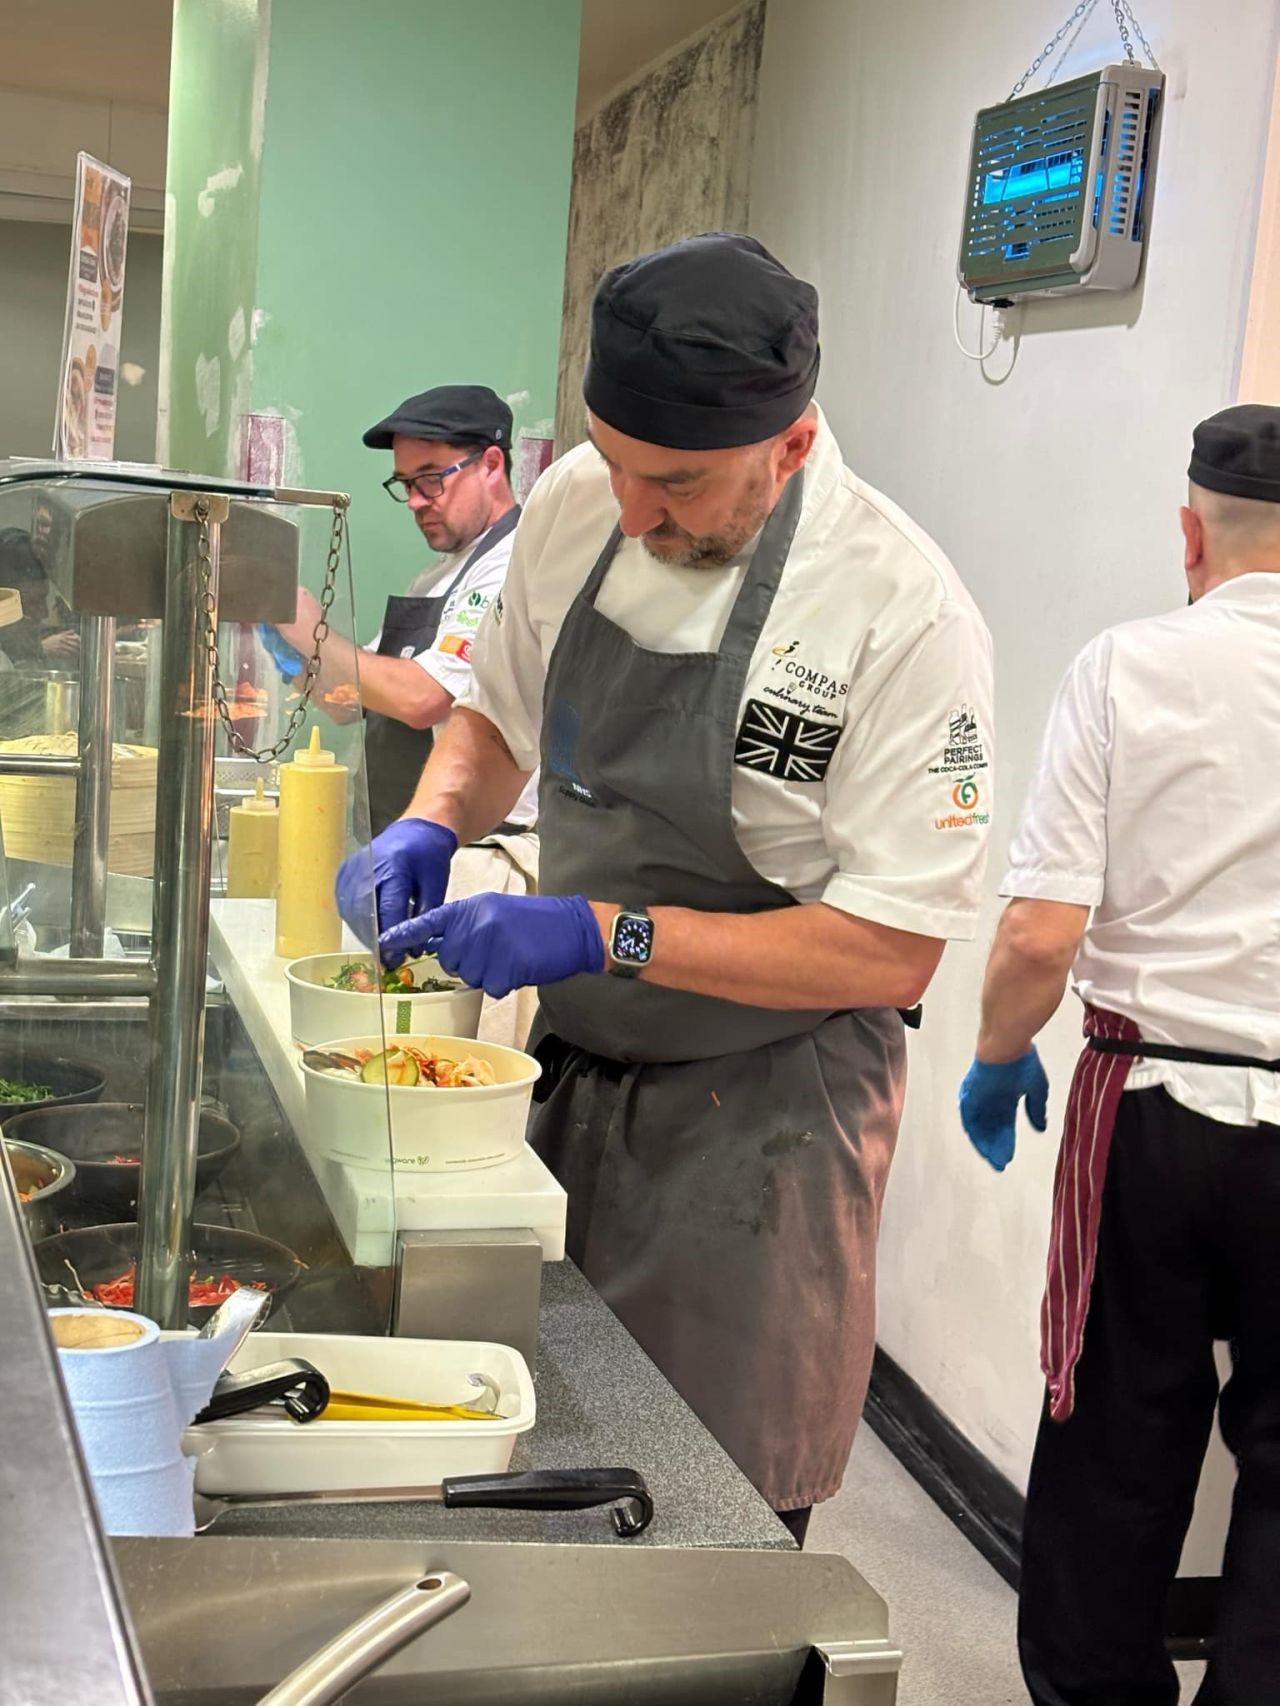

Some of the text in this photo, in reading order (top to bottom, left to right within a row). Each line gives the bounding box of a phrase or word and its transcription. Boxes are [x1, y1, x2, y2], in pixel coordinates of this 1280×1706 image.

[799, 680, 837, 701] GROUP
[763, 686, 838, 719] culinary team
[944, 744, 982, 757] PERFECT
[944, 753, 983, 765] PAIRINGS
[928, 766, 940, 774] THE
[940, 763, 973, 774] COCA-COLA
